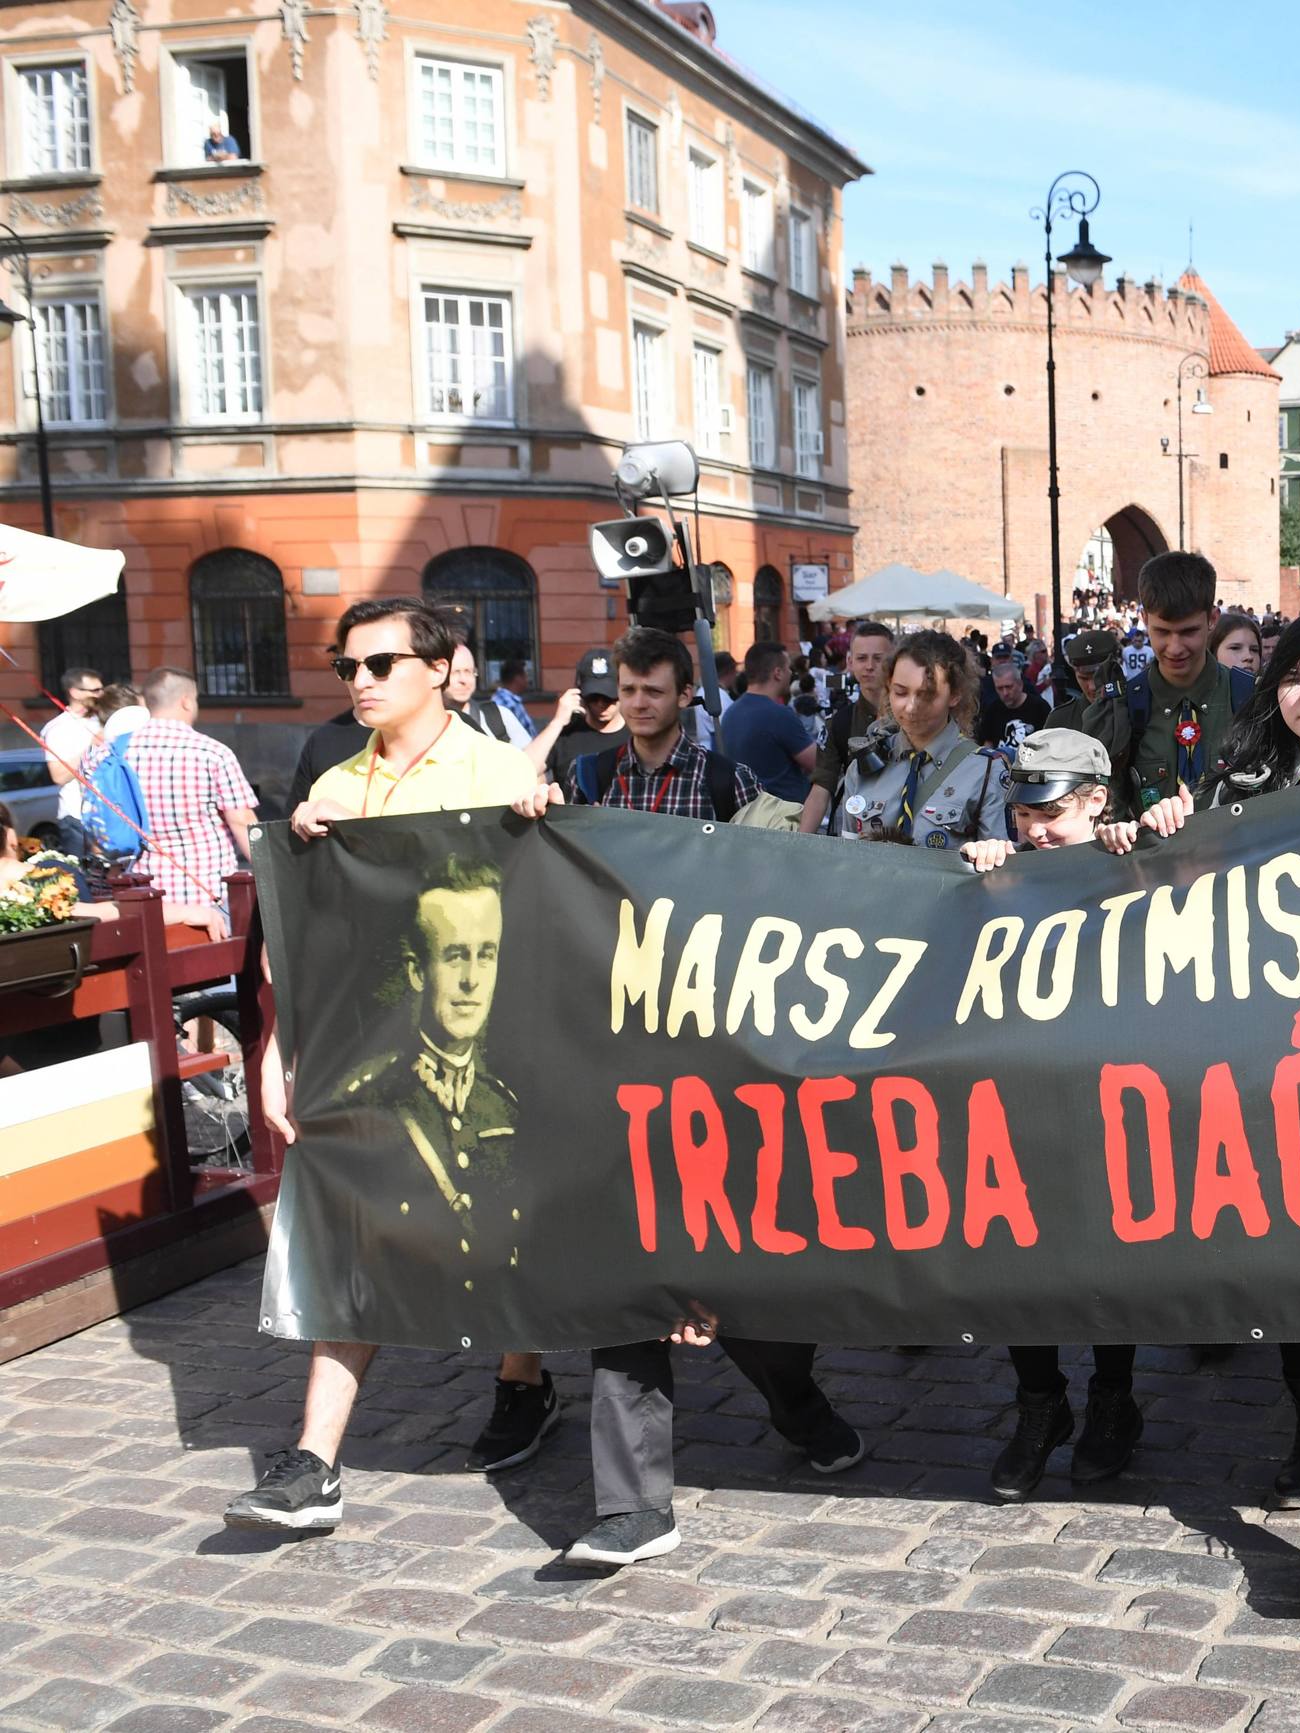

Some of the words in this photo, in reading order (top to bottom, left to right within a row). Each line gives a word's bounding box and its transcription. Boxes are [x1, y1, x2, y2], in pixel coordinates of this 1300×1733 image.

[1128, 653, 1147, 669] 89
[610, 897, 929, 1049] MARSZ
[616, 1076, 1039, 1255] TRZEBA
